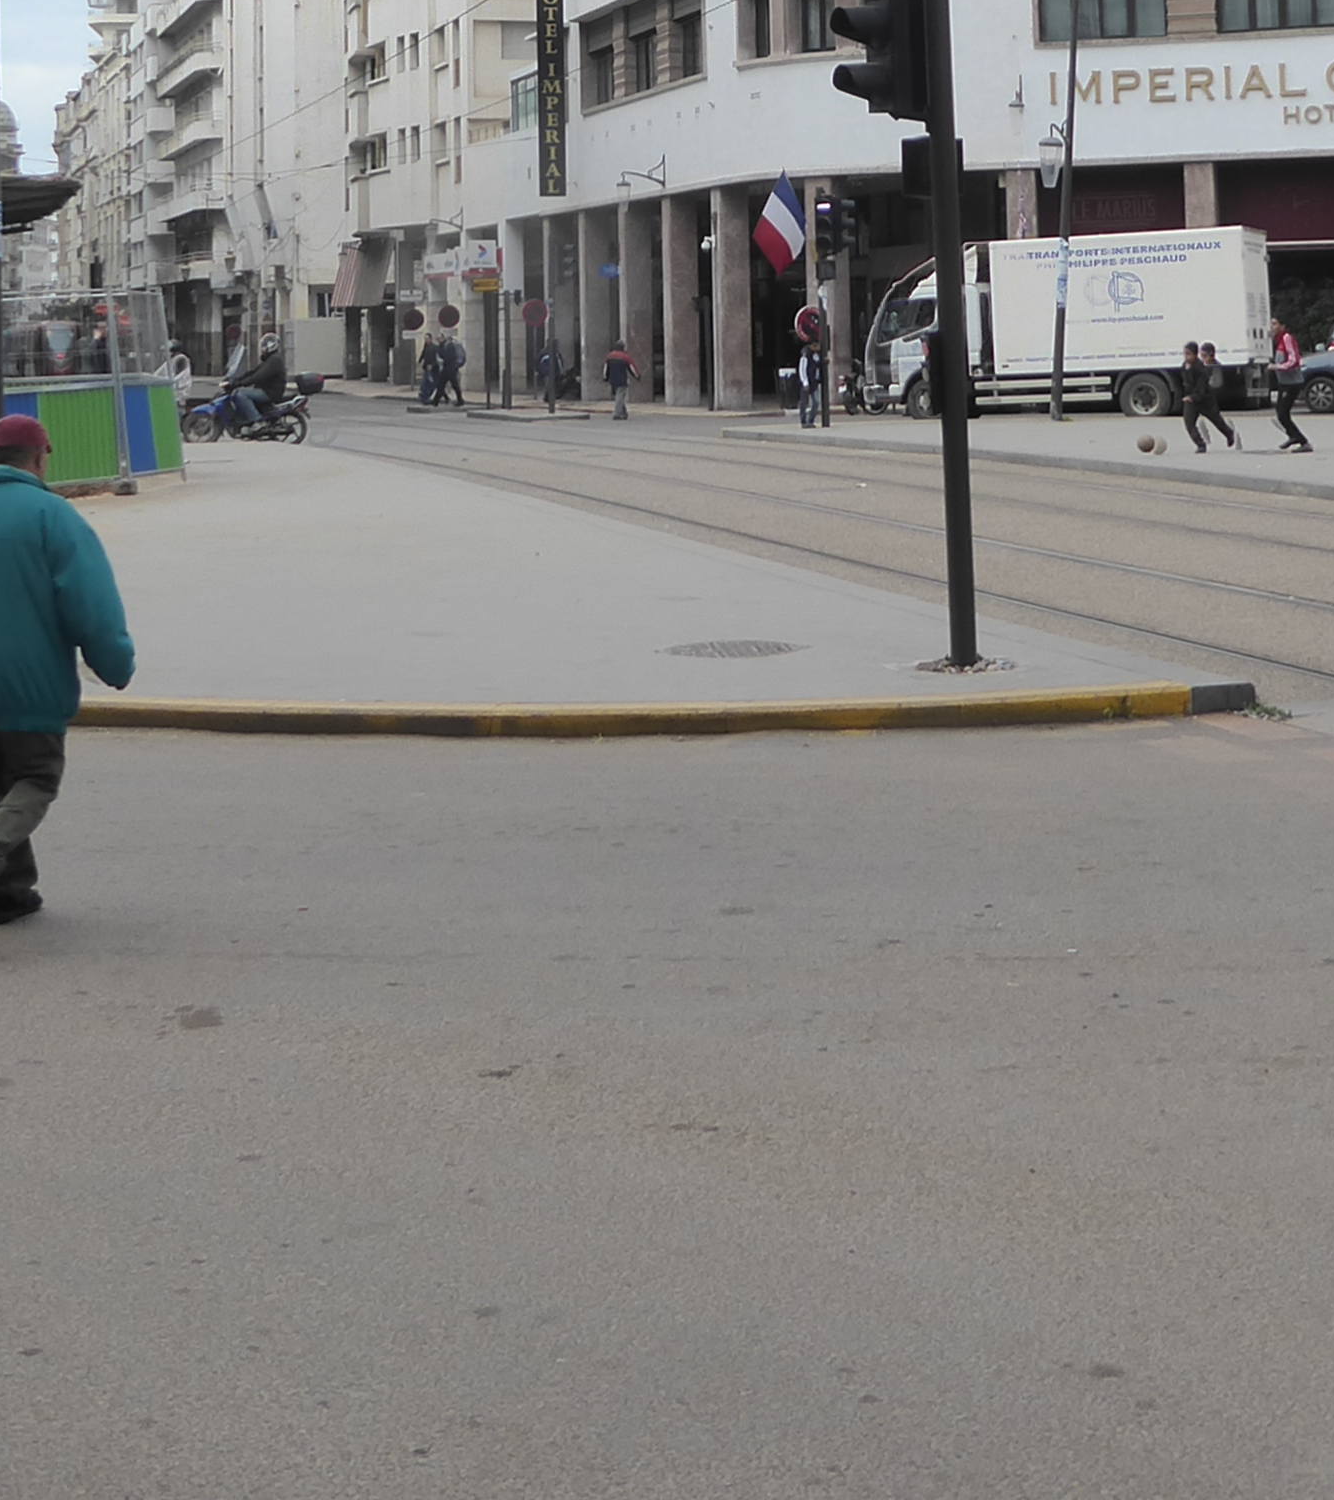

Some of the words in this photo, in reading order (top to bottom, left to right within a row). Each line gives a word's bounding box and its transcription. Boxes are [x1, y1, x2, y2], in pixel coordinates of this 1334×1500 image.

[1049, 63, 1307, 105] IMPERIAL
[542, 63, 562, 194] IMPERIAL
[1096, 199, 1156, 219] MARIUS
[1068, 257, 1118, 269] HILIPPE
